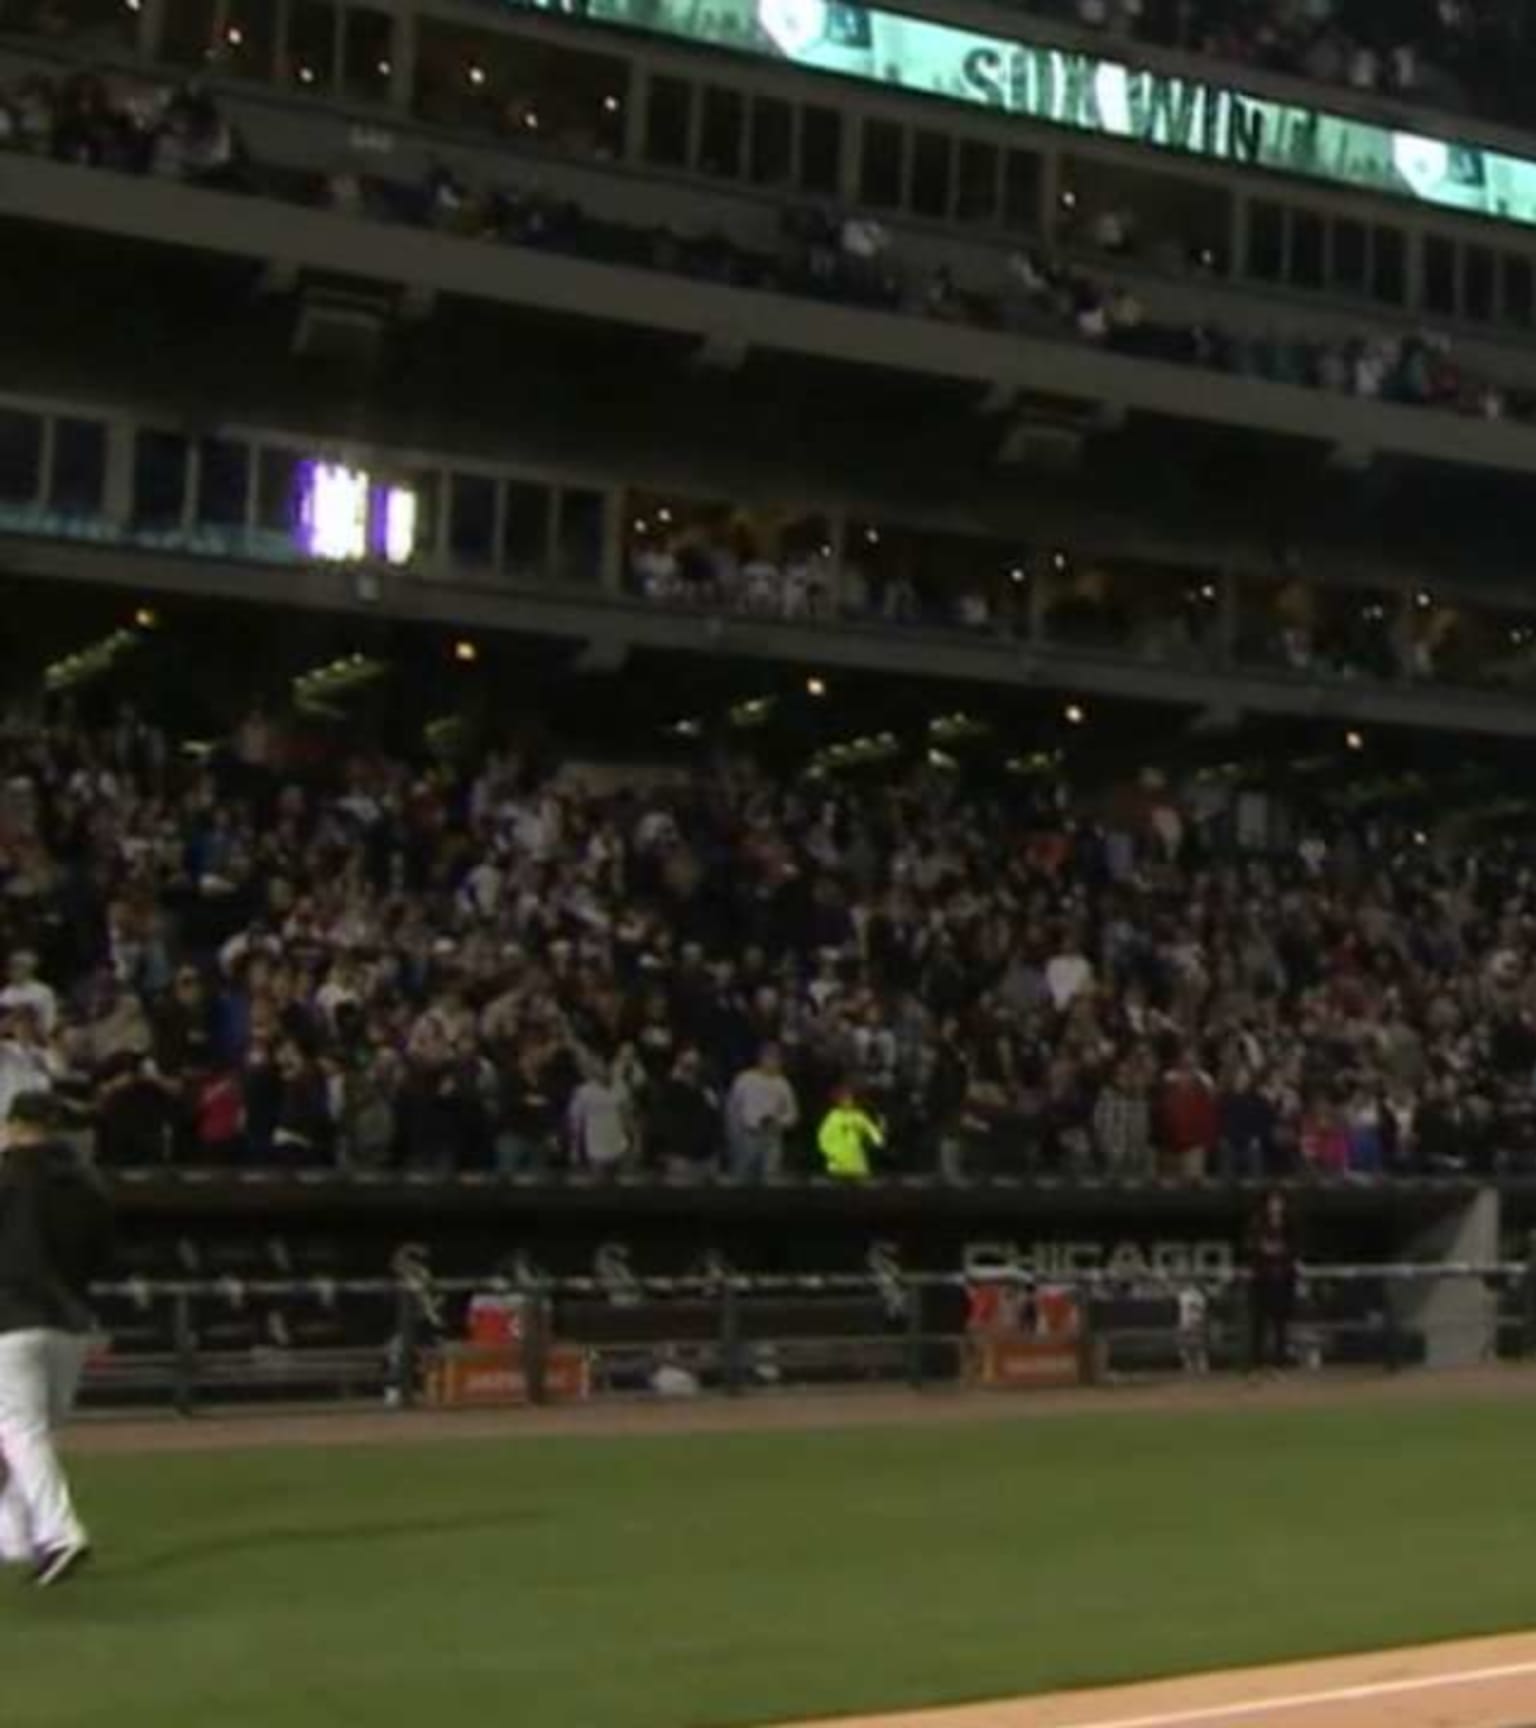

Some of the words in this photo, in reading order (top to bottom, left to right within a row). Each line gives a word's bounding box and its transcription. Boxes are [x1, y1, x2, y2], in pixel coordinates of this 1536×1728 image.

[961, 46, 1101, 133] SOX
[1125, 69, 1265, 162] WIN
[963, 1240, 1235, 1290] CHICAGO
